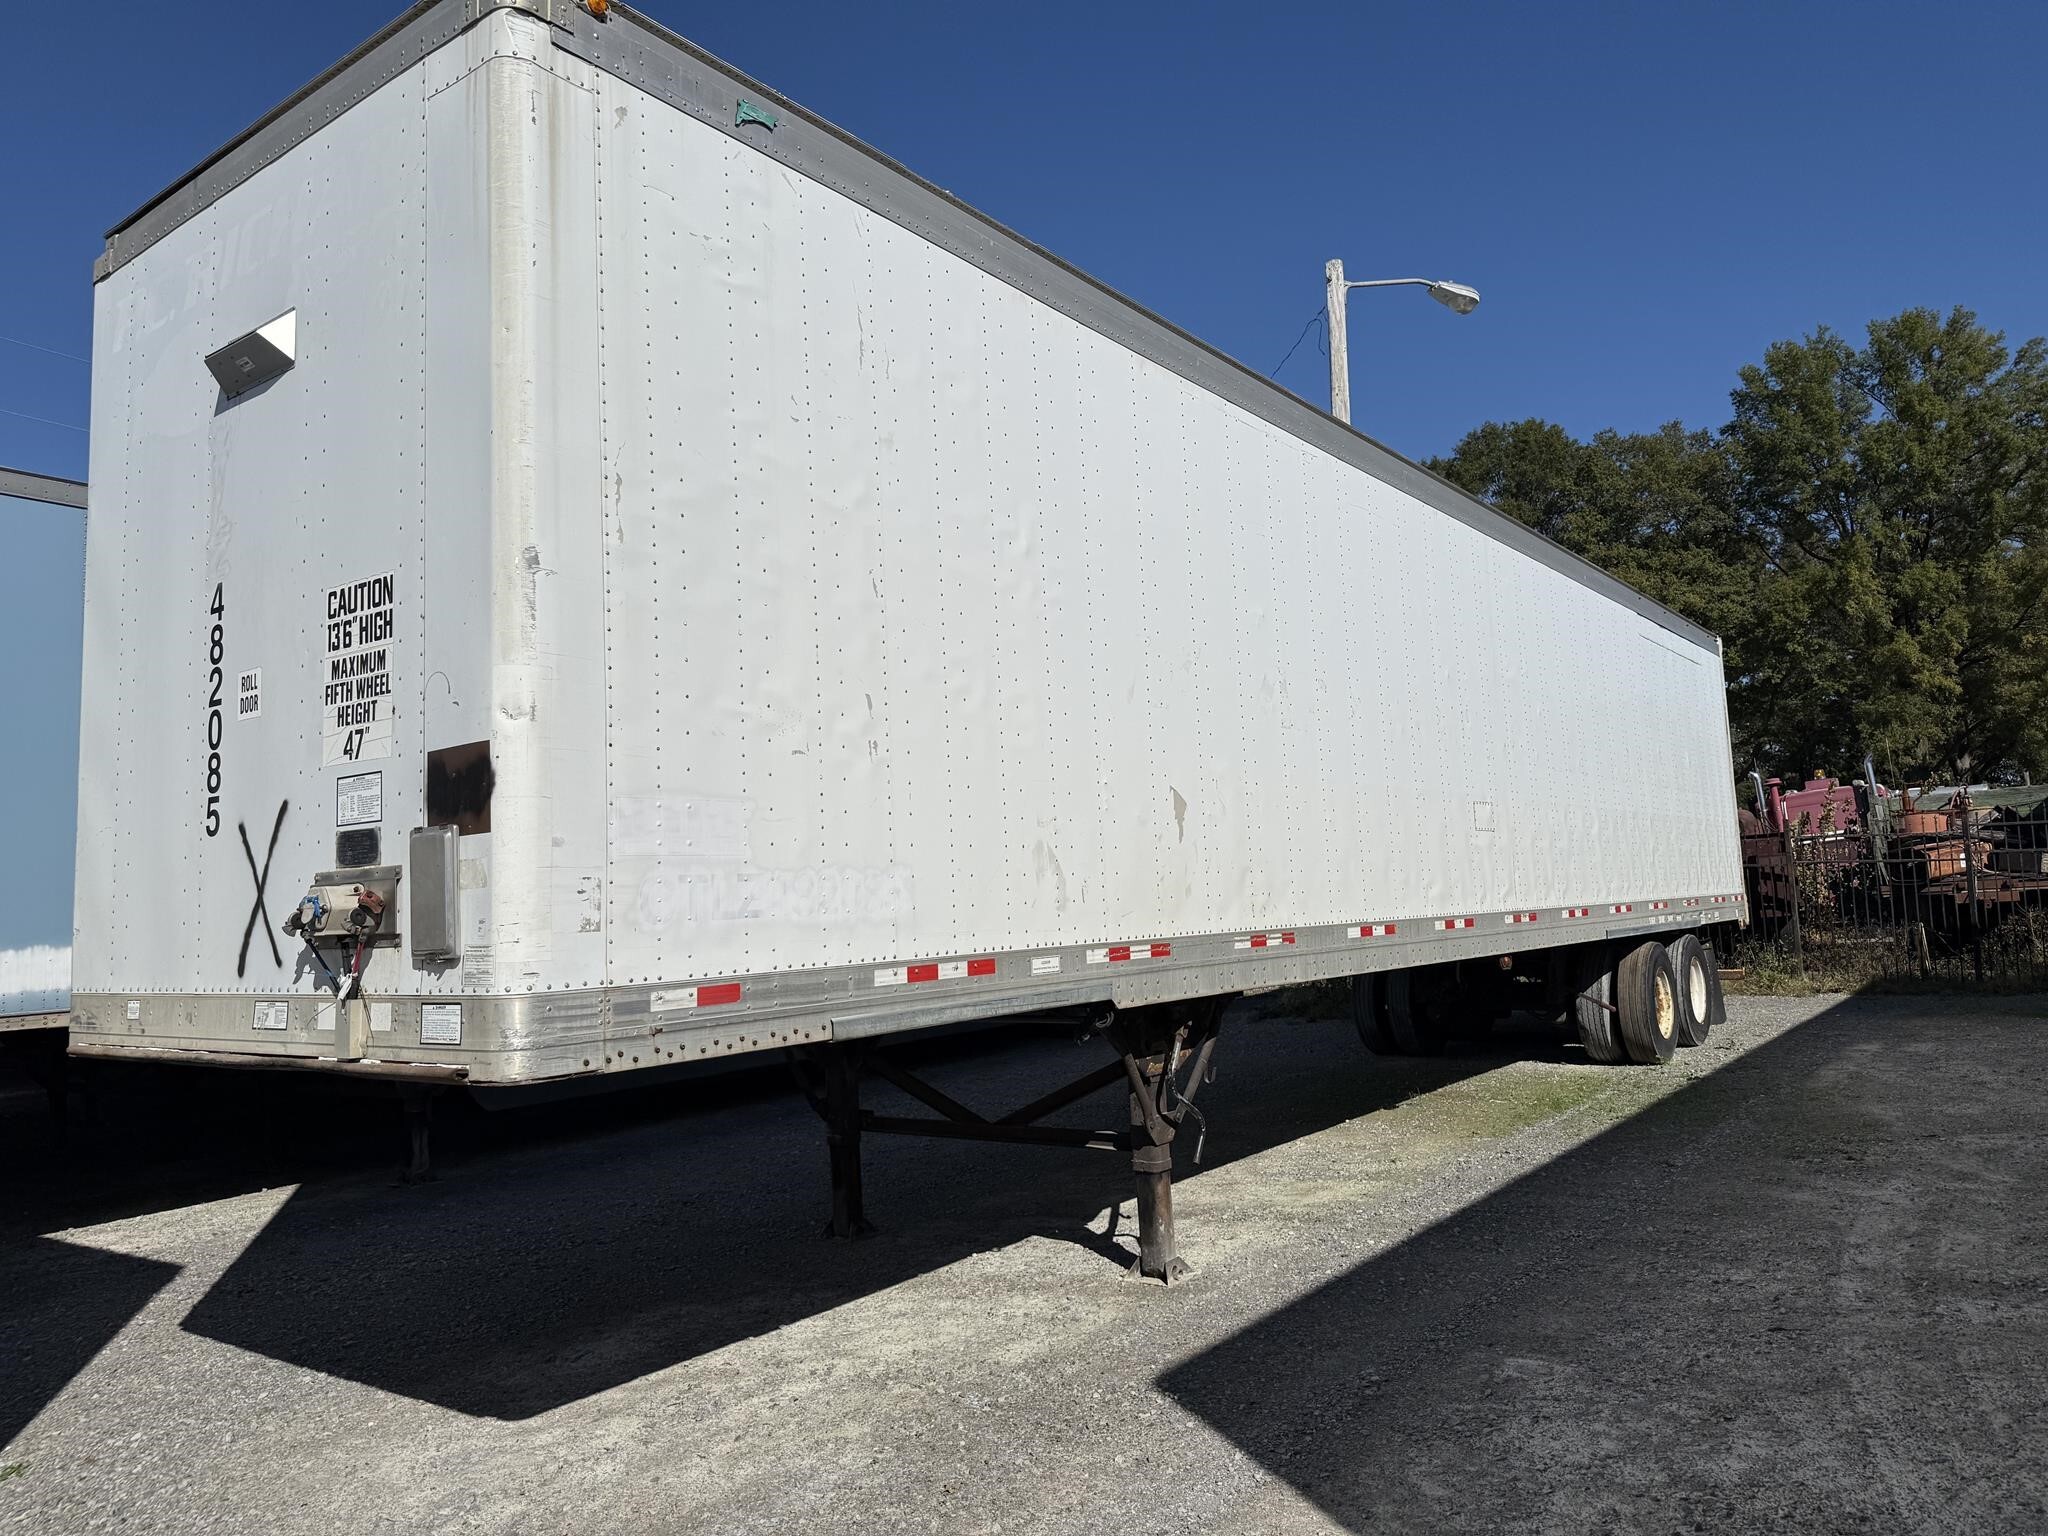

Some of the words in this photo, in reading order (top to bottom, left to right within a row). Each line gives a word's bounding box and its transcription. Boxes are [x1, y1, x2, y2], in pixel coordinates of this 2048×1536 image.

[328, 574, 393, 620] CAUTION
[327, 616, 358, 653] 13'6"
[359, 608, 393, 645] HIGH
[331, 649, 386, 681] MAXIMUM
[241, 673, 258, 693] ROLL
[325, 681, 353, 706] FIFTH
[356, 673, 391, 700] WHEEL
[205, 582, 225, 837] 482085
[240, 694, 259, 715] DOOR
[337, 700, 378, 728] HEIGHT
[343, 726, 370, 761] 47"
